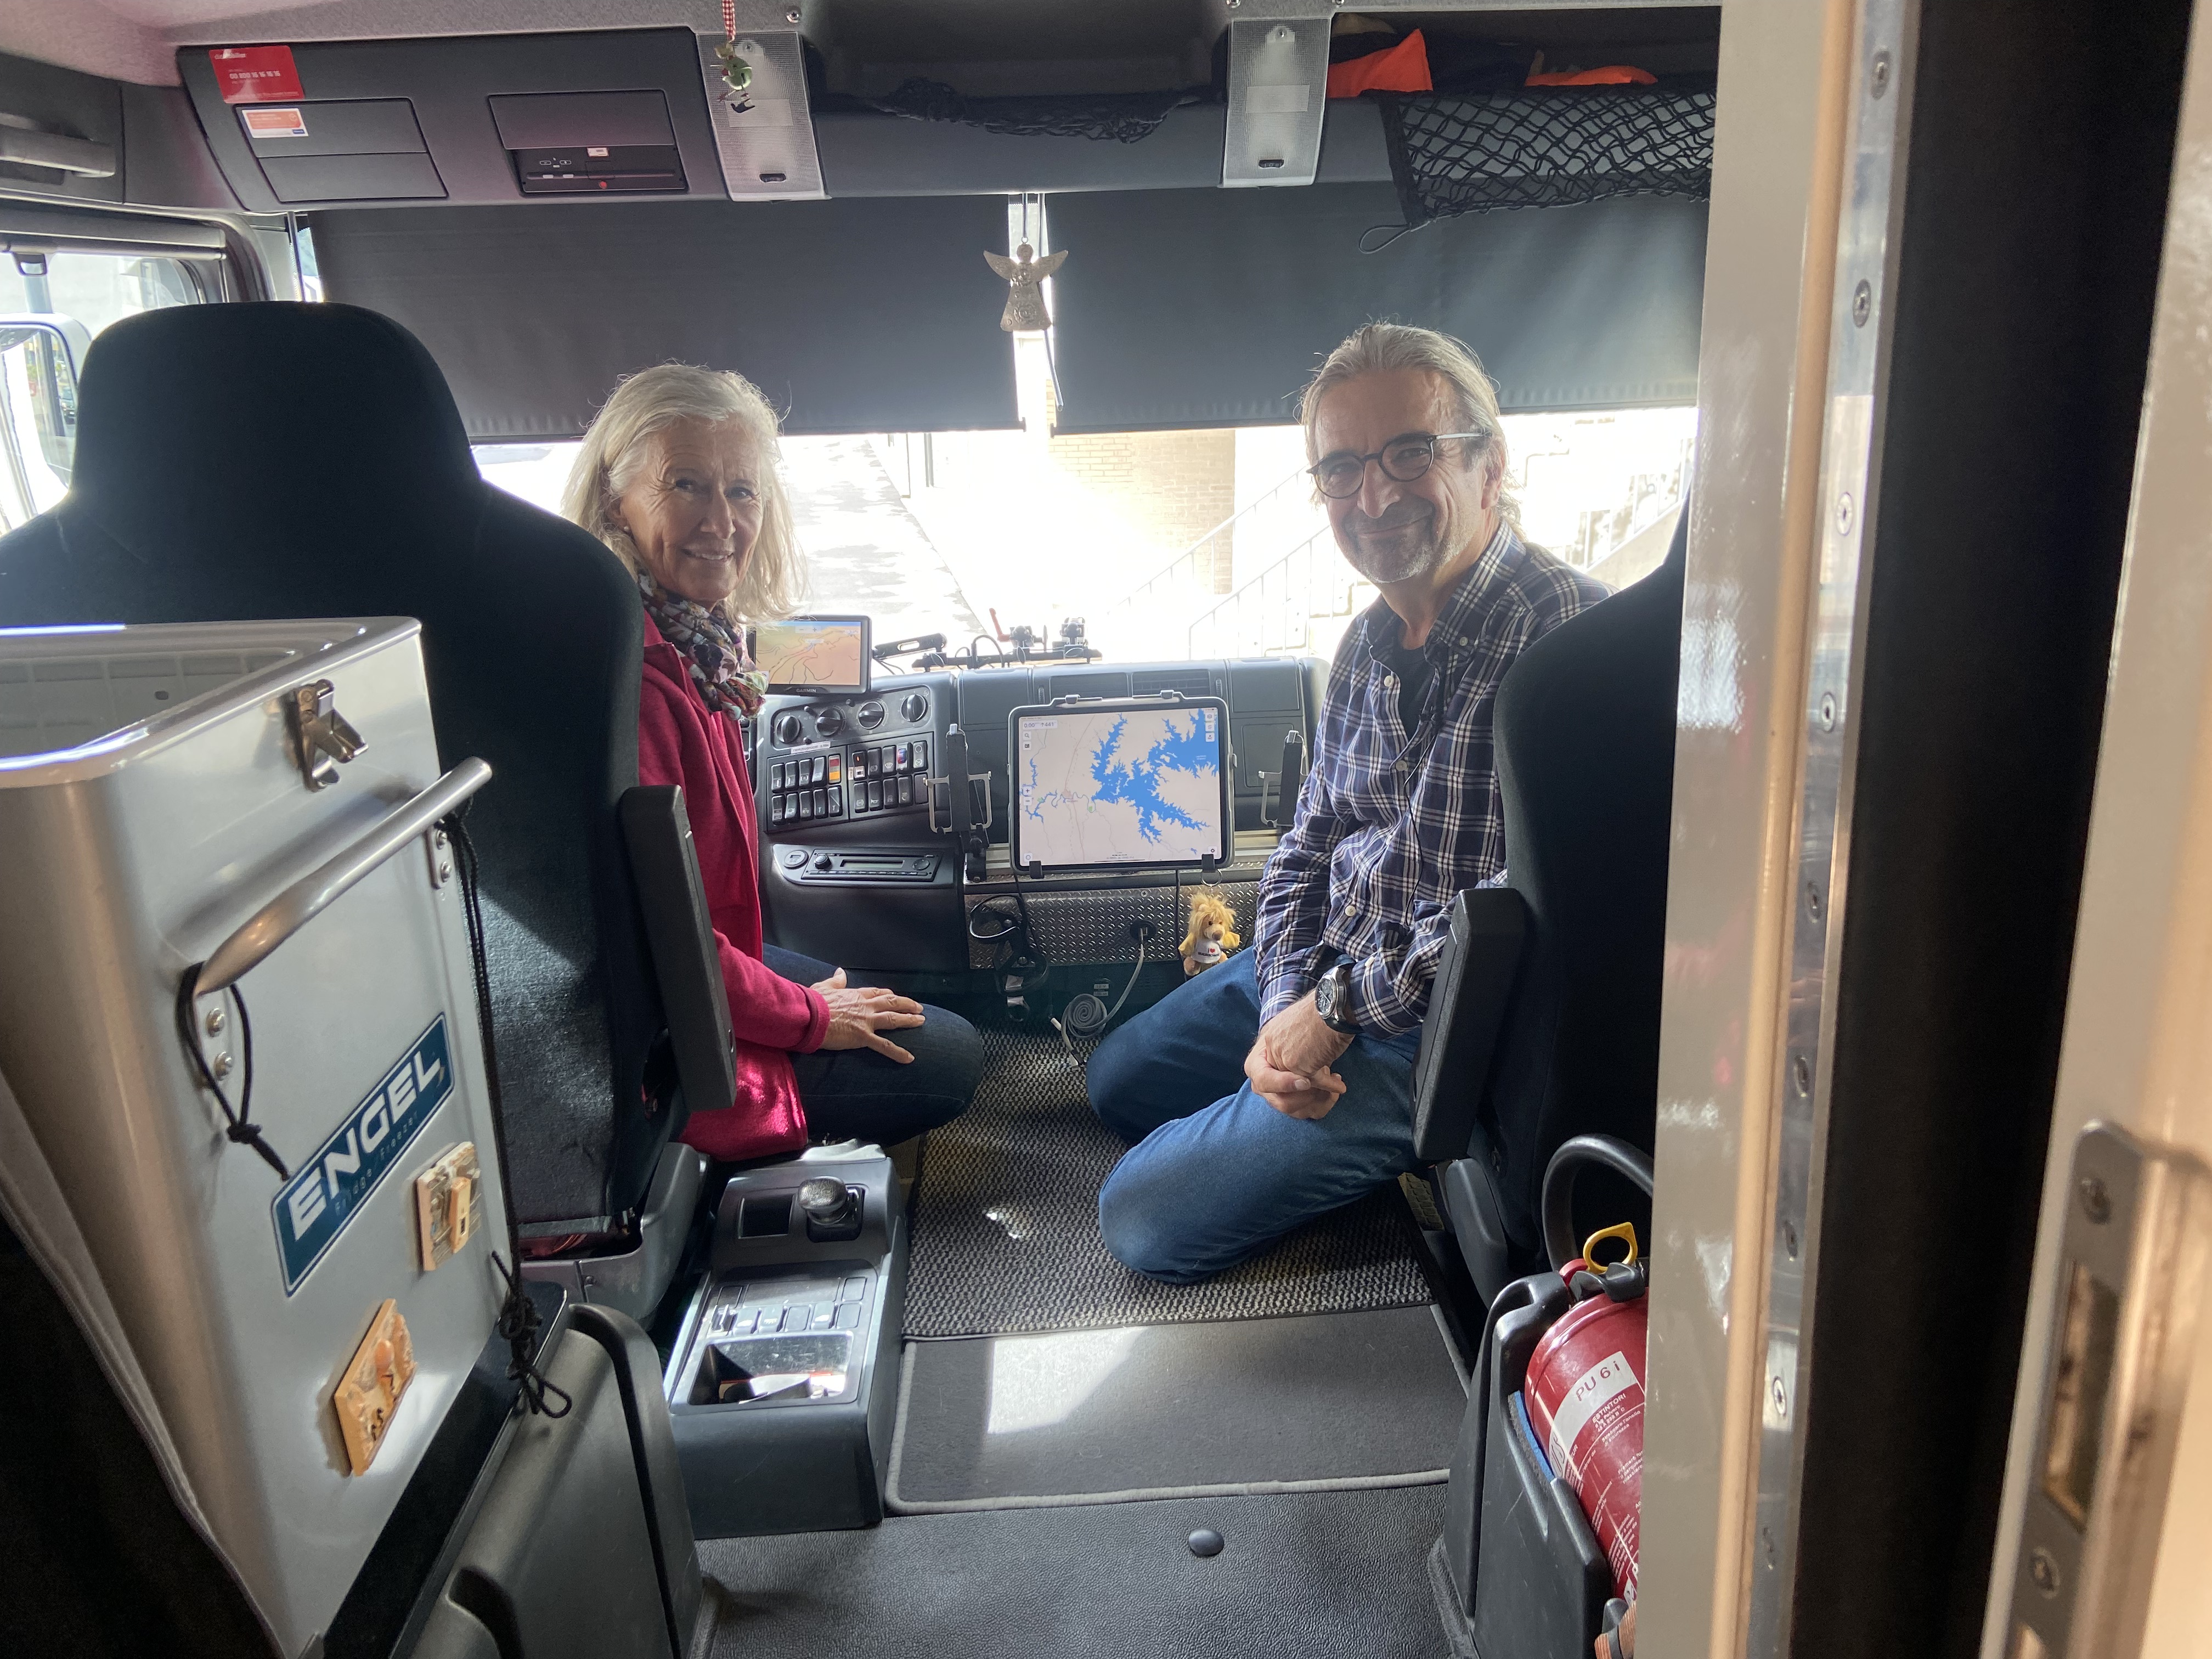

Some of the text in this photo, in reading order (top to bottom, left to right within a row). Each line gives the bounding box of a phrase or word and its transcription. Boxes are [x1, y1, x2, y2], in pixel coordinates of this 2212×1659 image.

[287, 1050, 442, 1241] ENGEL
[1576, 1361, 1620, 1401] PU 6 i
[1592, 1393, 1626, 1424] ESTINTORI
